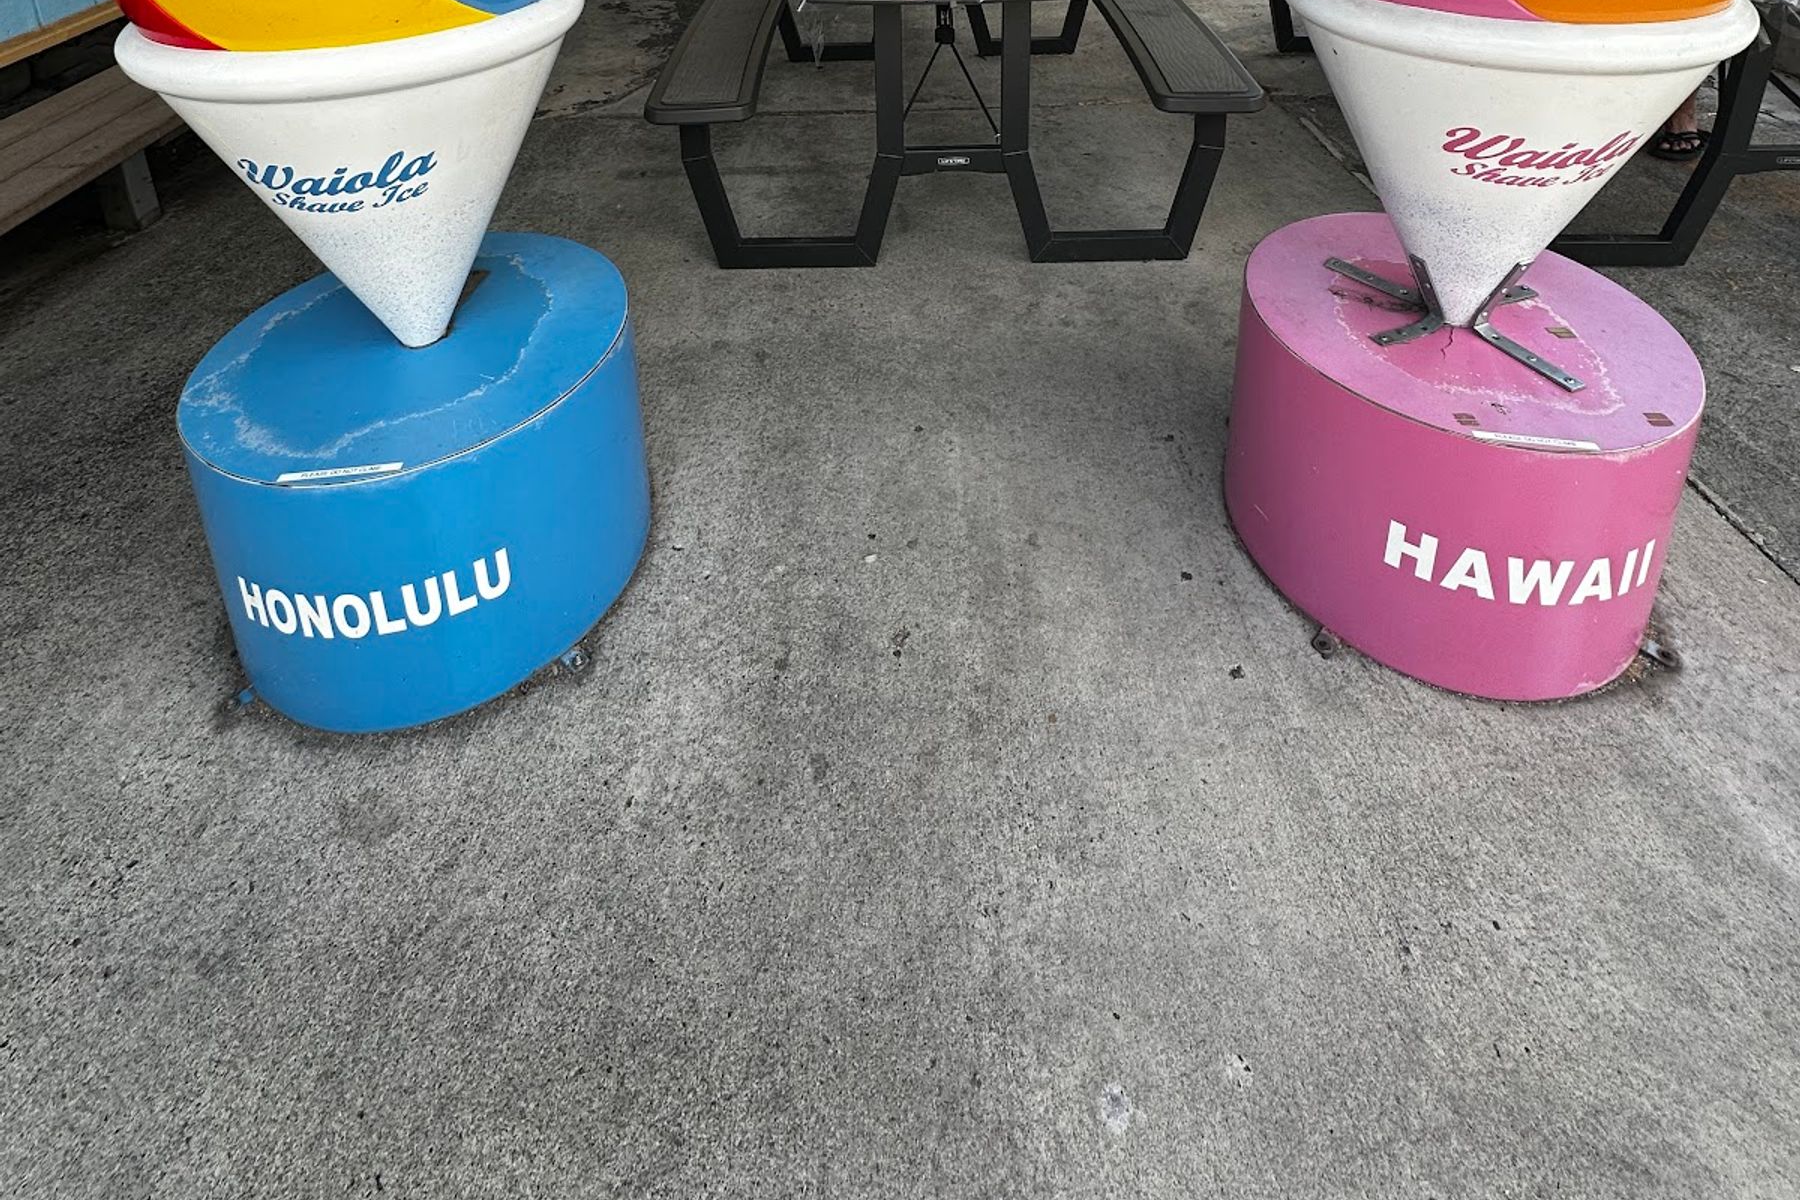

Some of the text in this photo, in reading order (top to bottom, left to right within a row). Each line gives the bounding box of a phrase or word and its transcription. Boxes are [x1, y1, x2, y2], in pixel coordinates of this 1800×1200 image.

[1441, 127, 1645, 170] Waiola
[237, 150, 438, 196] Waiola
[1450, 162, 1560, 187] Shave
[272, 181, 429, 213] Shave Ice
[1383, 519, 1656, 606] HAWAII
[237, 547, 511, 638] HONOLULU
